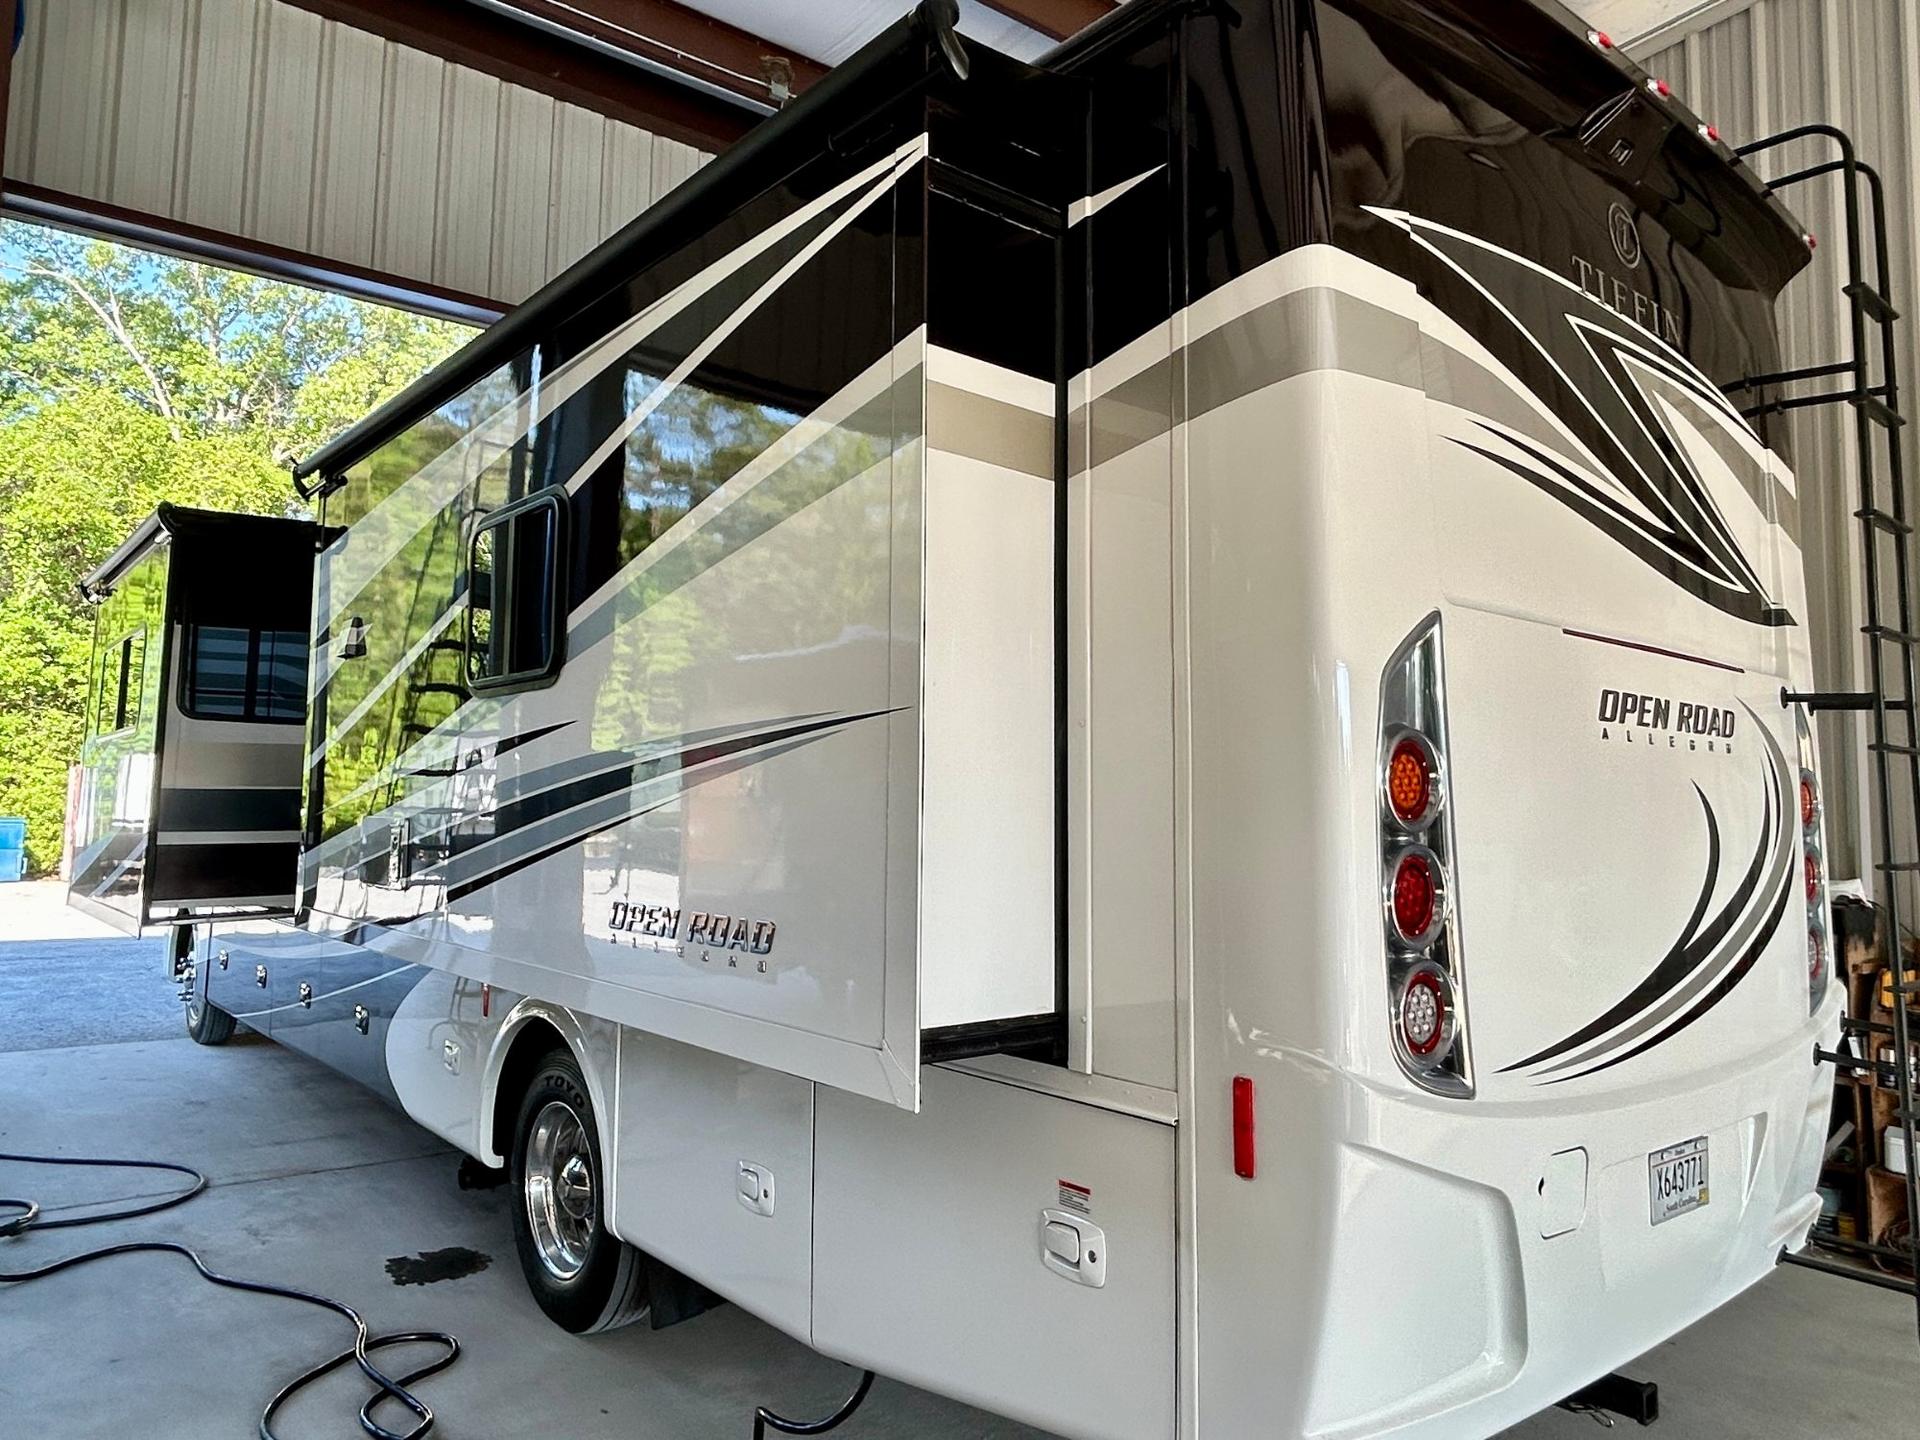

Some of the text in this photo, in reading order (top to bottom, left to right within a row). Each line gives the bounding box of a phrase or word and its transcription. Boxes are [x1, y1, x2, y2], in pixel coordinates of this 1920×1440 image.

[1572, 255, 1684, 346] TIFFIN
[1598, 689, 1735, 738] OPEN ROAD
[1601, 727, 1732, 754] ALLEGRO
[609, 901, 777, 955] OPEN ROAD
[544, 1075, 586, 1109] TOYO
[1657, 1155, 1704, 1200] X643771
